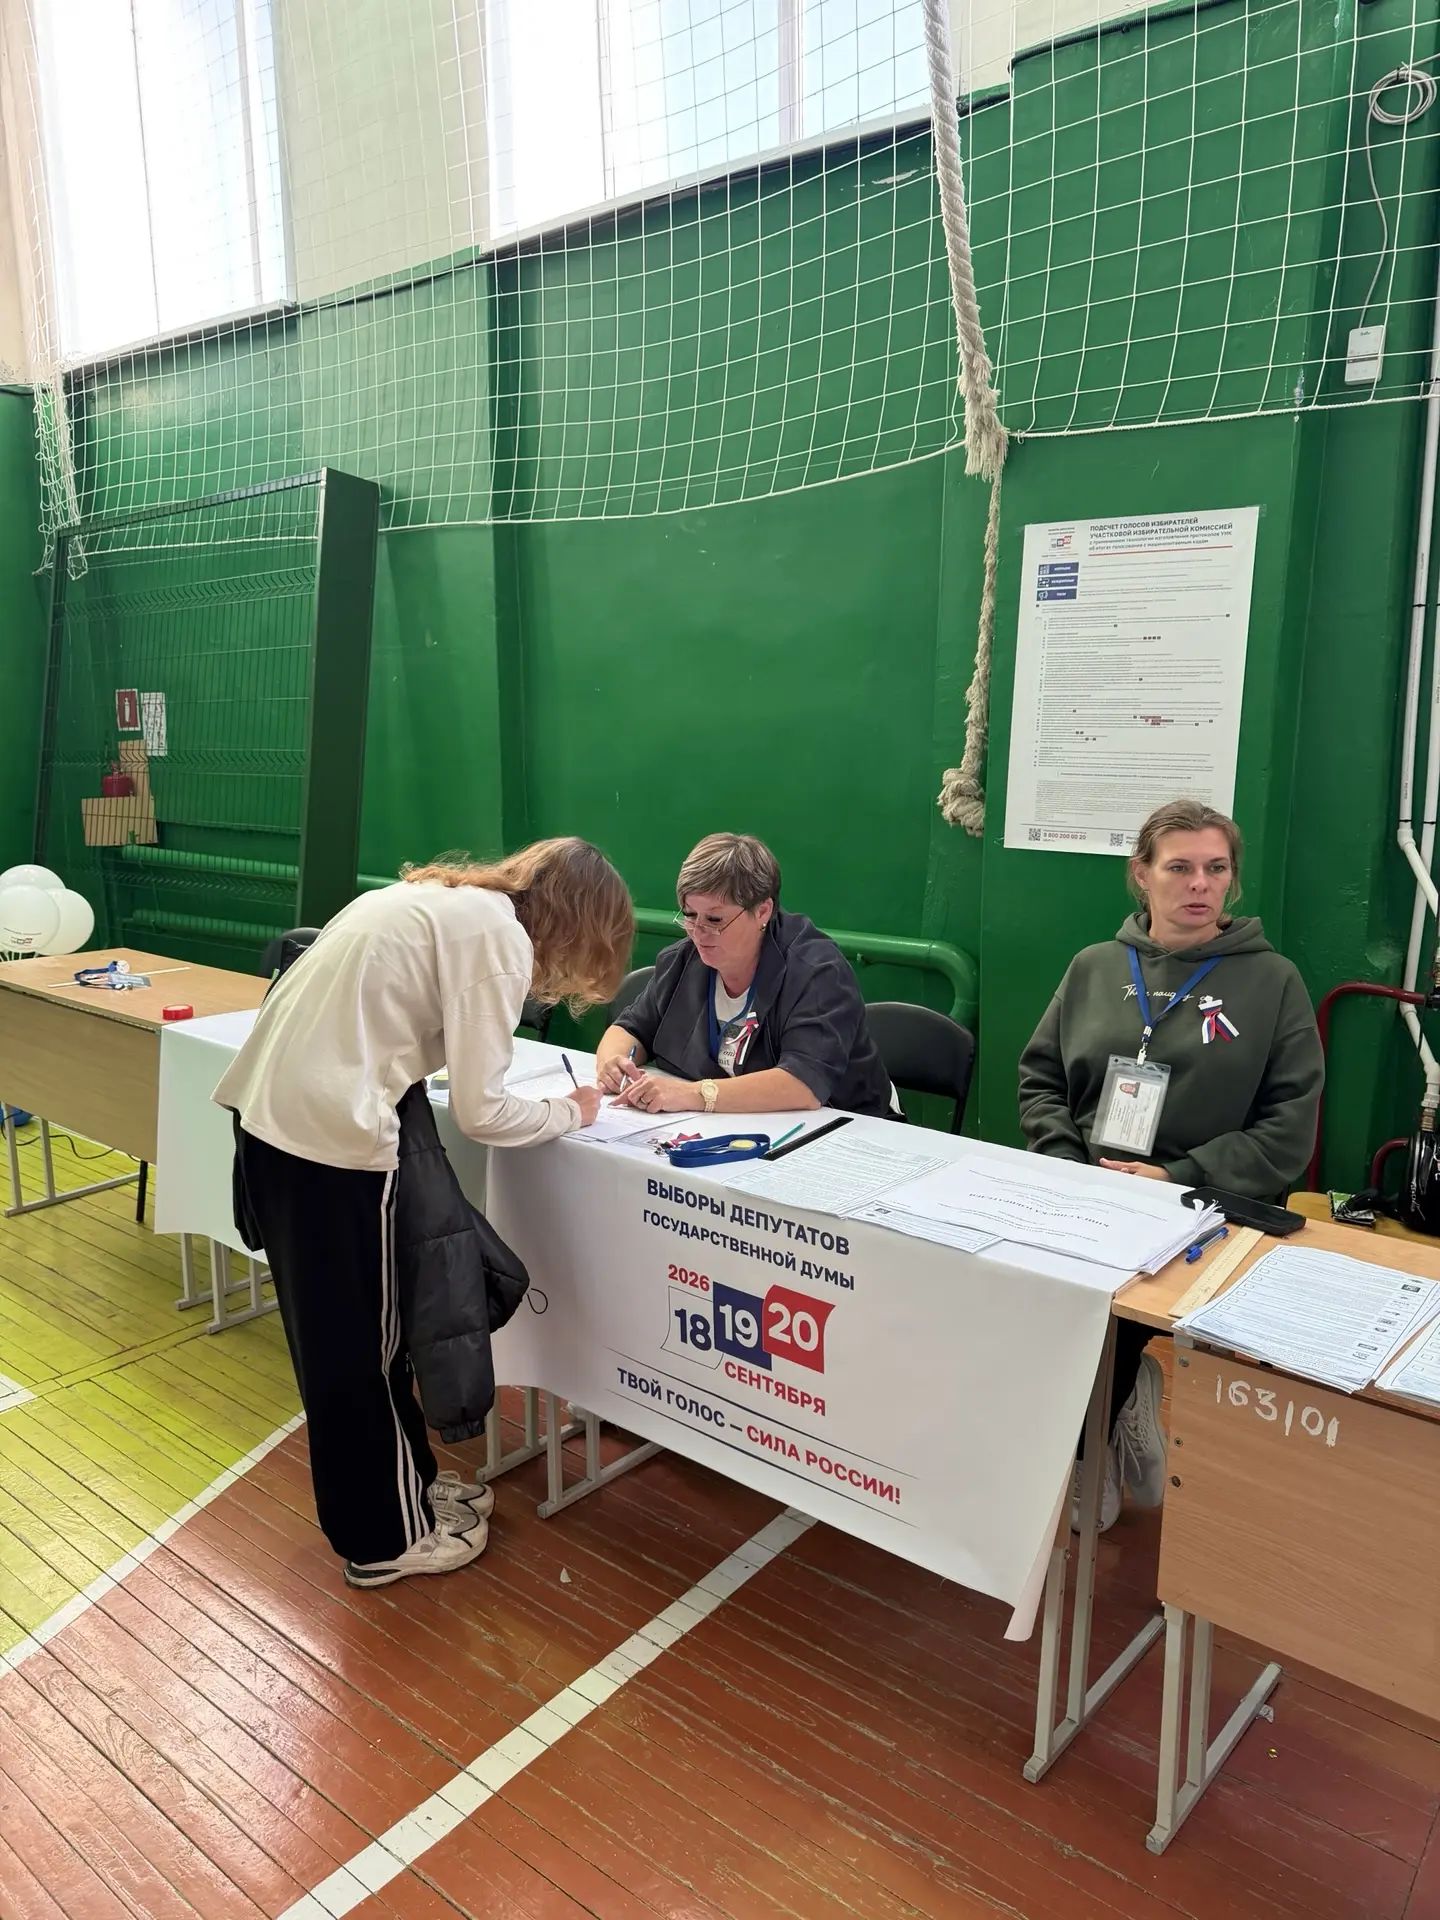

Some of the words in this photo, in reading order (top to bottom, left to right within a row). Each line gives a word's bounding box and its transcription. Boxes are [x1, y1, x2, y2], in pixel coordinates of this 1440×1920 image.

[1090, 523, 1119, 532] ПОДСЧЕТ
[1120, 521, 1150, 529] ГОЛОСОВ
[1151, 517, 1199, 527] ИЗБИРАТЕЛЕЙ
[1090, 530, 1132, 539] УЧАСТКОВОЙ
[1133, 526, 1189, 536] ИЗБИРАТЕЛЬНОЙ
[1190, 522, 1233, 532] КОМИССИЕЙ
[647, 1178, 725, 1218] ВЫБОРЫ
[730, 1204, 850, 1256] ДЕПУТАТОВ
[643, 1209, 796, 1272] ГОСУДАРСТВЕННОЙ
[800, 1261, 855, 1291] ДУМЫ
[668, 1263, 710, 1292] 2026
[675, 1308, 712, 1352] 18
[719, 1303, 759, 1349] 19
[768, 1302, 819, 1352] 20
[724, 1361, 826, 1416] СЕНТЯБРЯ
[617, 1367, 662, 1400] ТВОЙ
[666, 1390, 725, 1427] ГОЛОС
[747, 1425, 800, 1462] СИЛА
[806, 1449, 901, 1505] РОССИИ!
